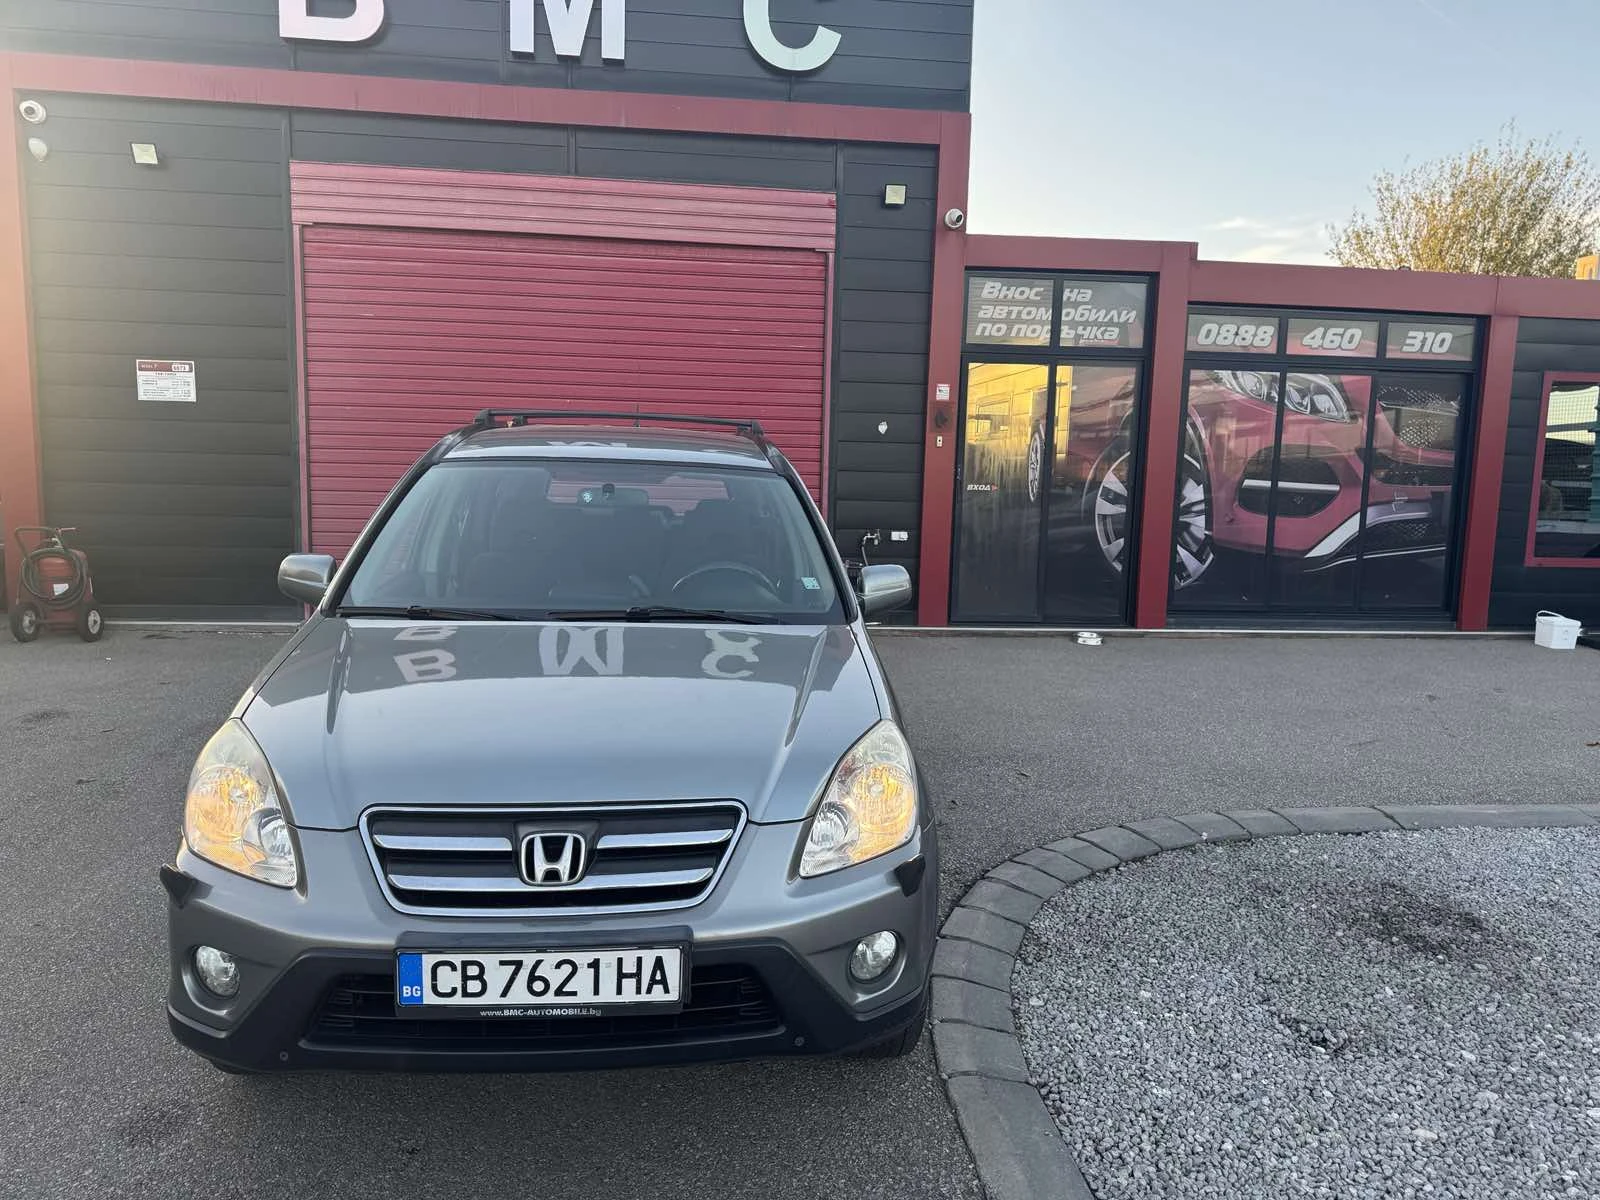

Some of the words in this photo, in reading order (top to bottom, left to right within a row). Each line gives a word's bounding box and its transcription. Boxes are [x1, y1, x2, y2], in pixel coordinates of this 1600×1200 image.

[981, 281, 1045, 301] Внос
[1063, 288, 1093, 302] на
[976, 322, 1007, 337] по
[1197, 323, 1275, 348] 0888
[1302, 327, 1362, 350] 460
[1402, 331, 1453, 353] 310
[499, 957, 601, 999] 7621
[403, 986, 421, 998] BG
